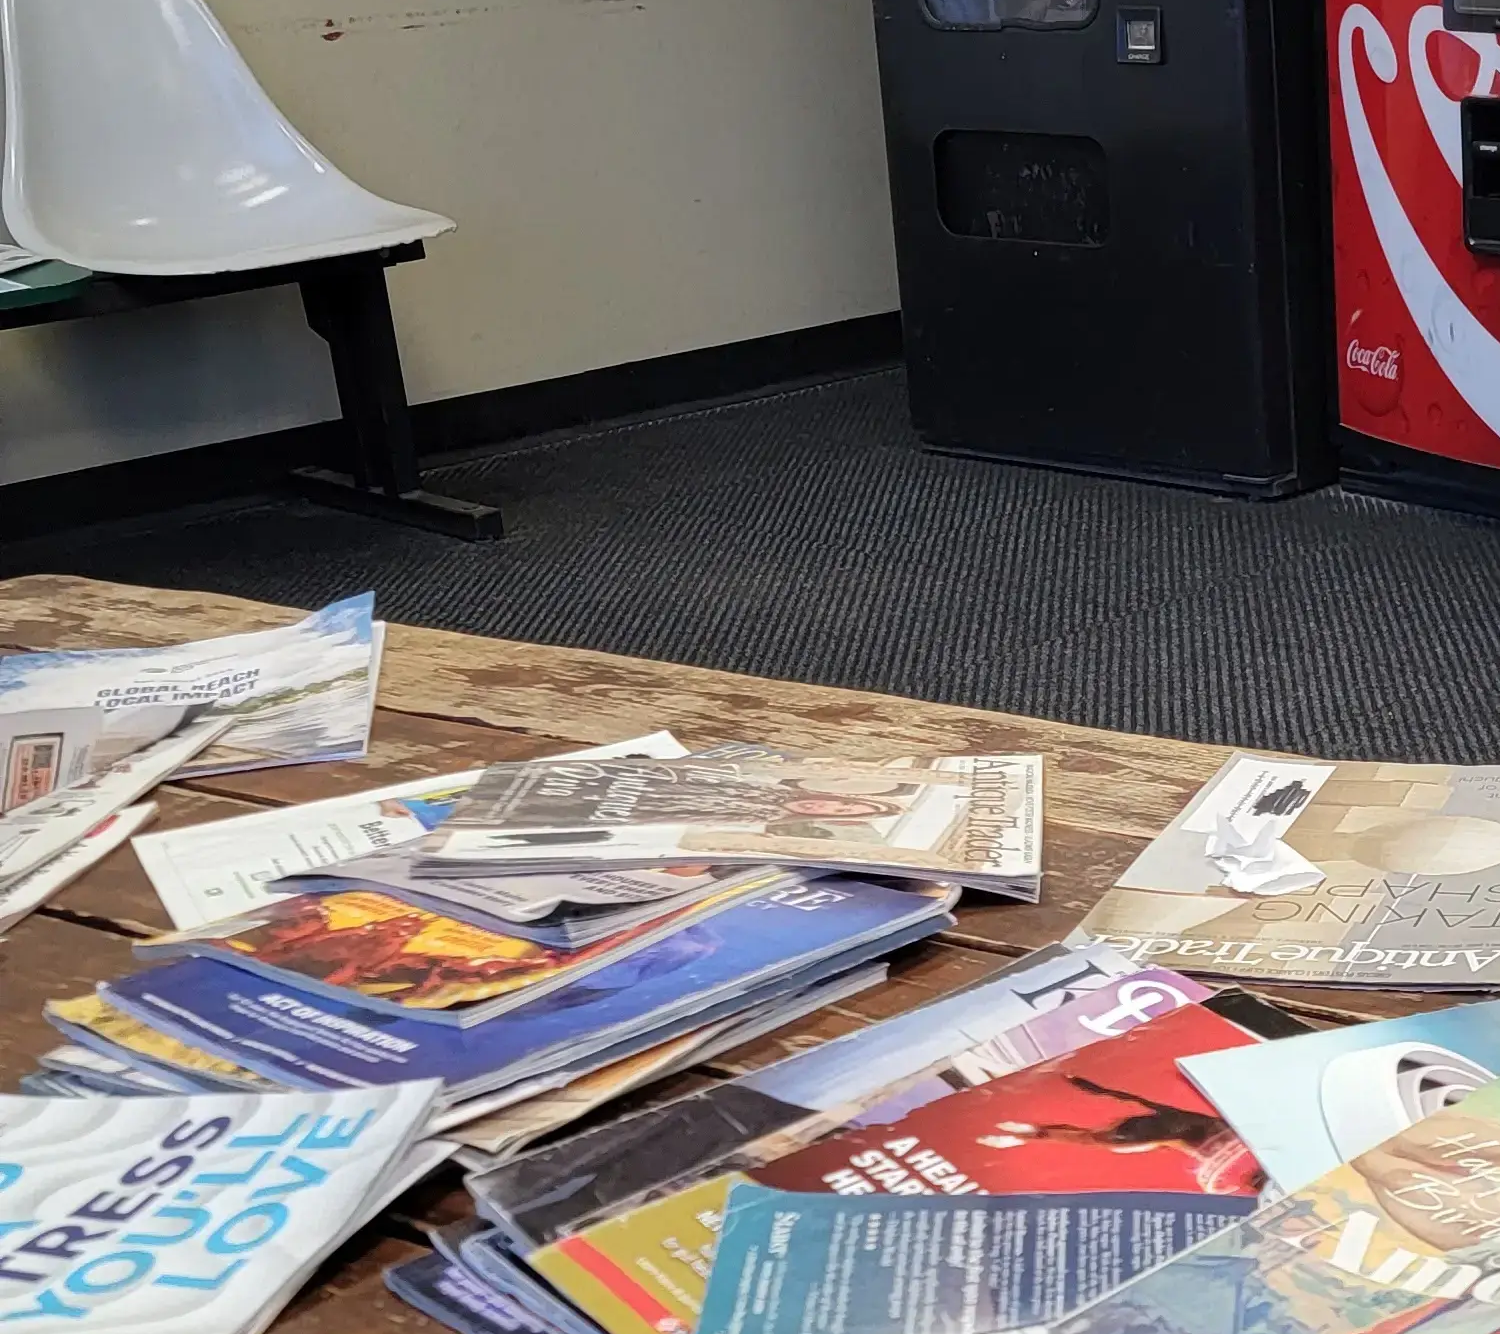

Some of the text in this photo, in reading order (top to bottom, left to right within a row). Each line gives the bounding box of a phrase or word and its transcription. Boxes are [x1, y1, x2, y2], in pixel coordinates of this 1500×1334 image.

[97, 679, 184, 699] GLOBAL
[953, 757, 1022, 868] Antique Trader
[358, 819, 392, 849] Better
[1073, 932, 1265, 968] Trader
[883, 1136, 921, 1157] A
[151, 1108, 377, 1291] LOVE
